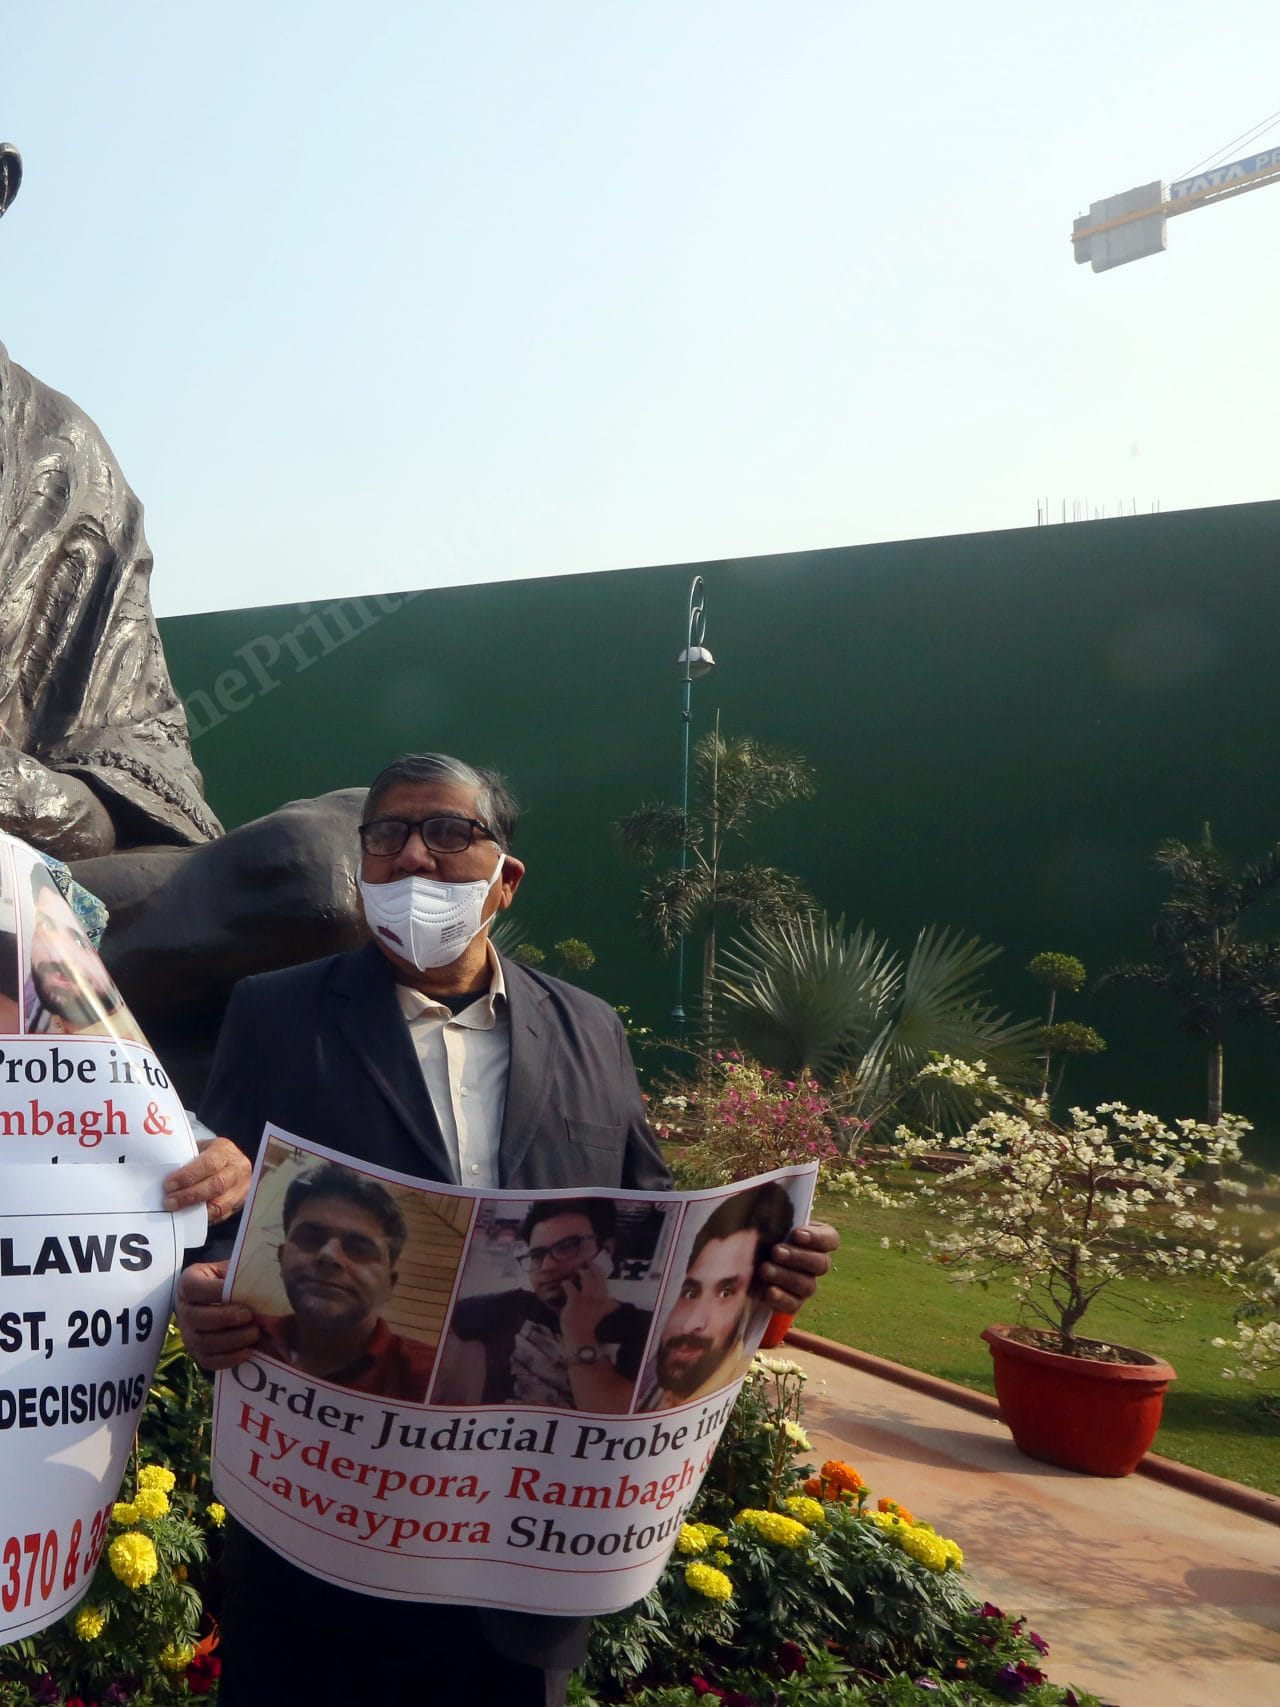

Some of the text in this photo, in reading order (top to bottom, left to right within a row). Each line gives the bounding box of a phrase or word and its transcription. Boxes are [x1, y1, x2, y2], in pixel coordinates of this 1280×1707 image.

[1173, 165, 1245, 199] TATA
[143, 1101, 173, 1135] &
[0, 1234, 152, 1277] LAWS
[67, 1306, 153, 1349] 2019
[233, 1359, 364, 1436] Order
[372, 1411, 558, 1455] Judicial
[571, 1423, 687, 1461] Probe
[238, 1403, 492, 1503] Hyderpora,
[504, 1457, 694, 1511] Rambagh
[248, 1450, 491, 1548] Lawaypora
[1, 1530, 57, 1613] 370
[63, 1519, 82, 1591] &
